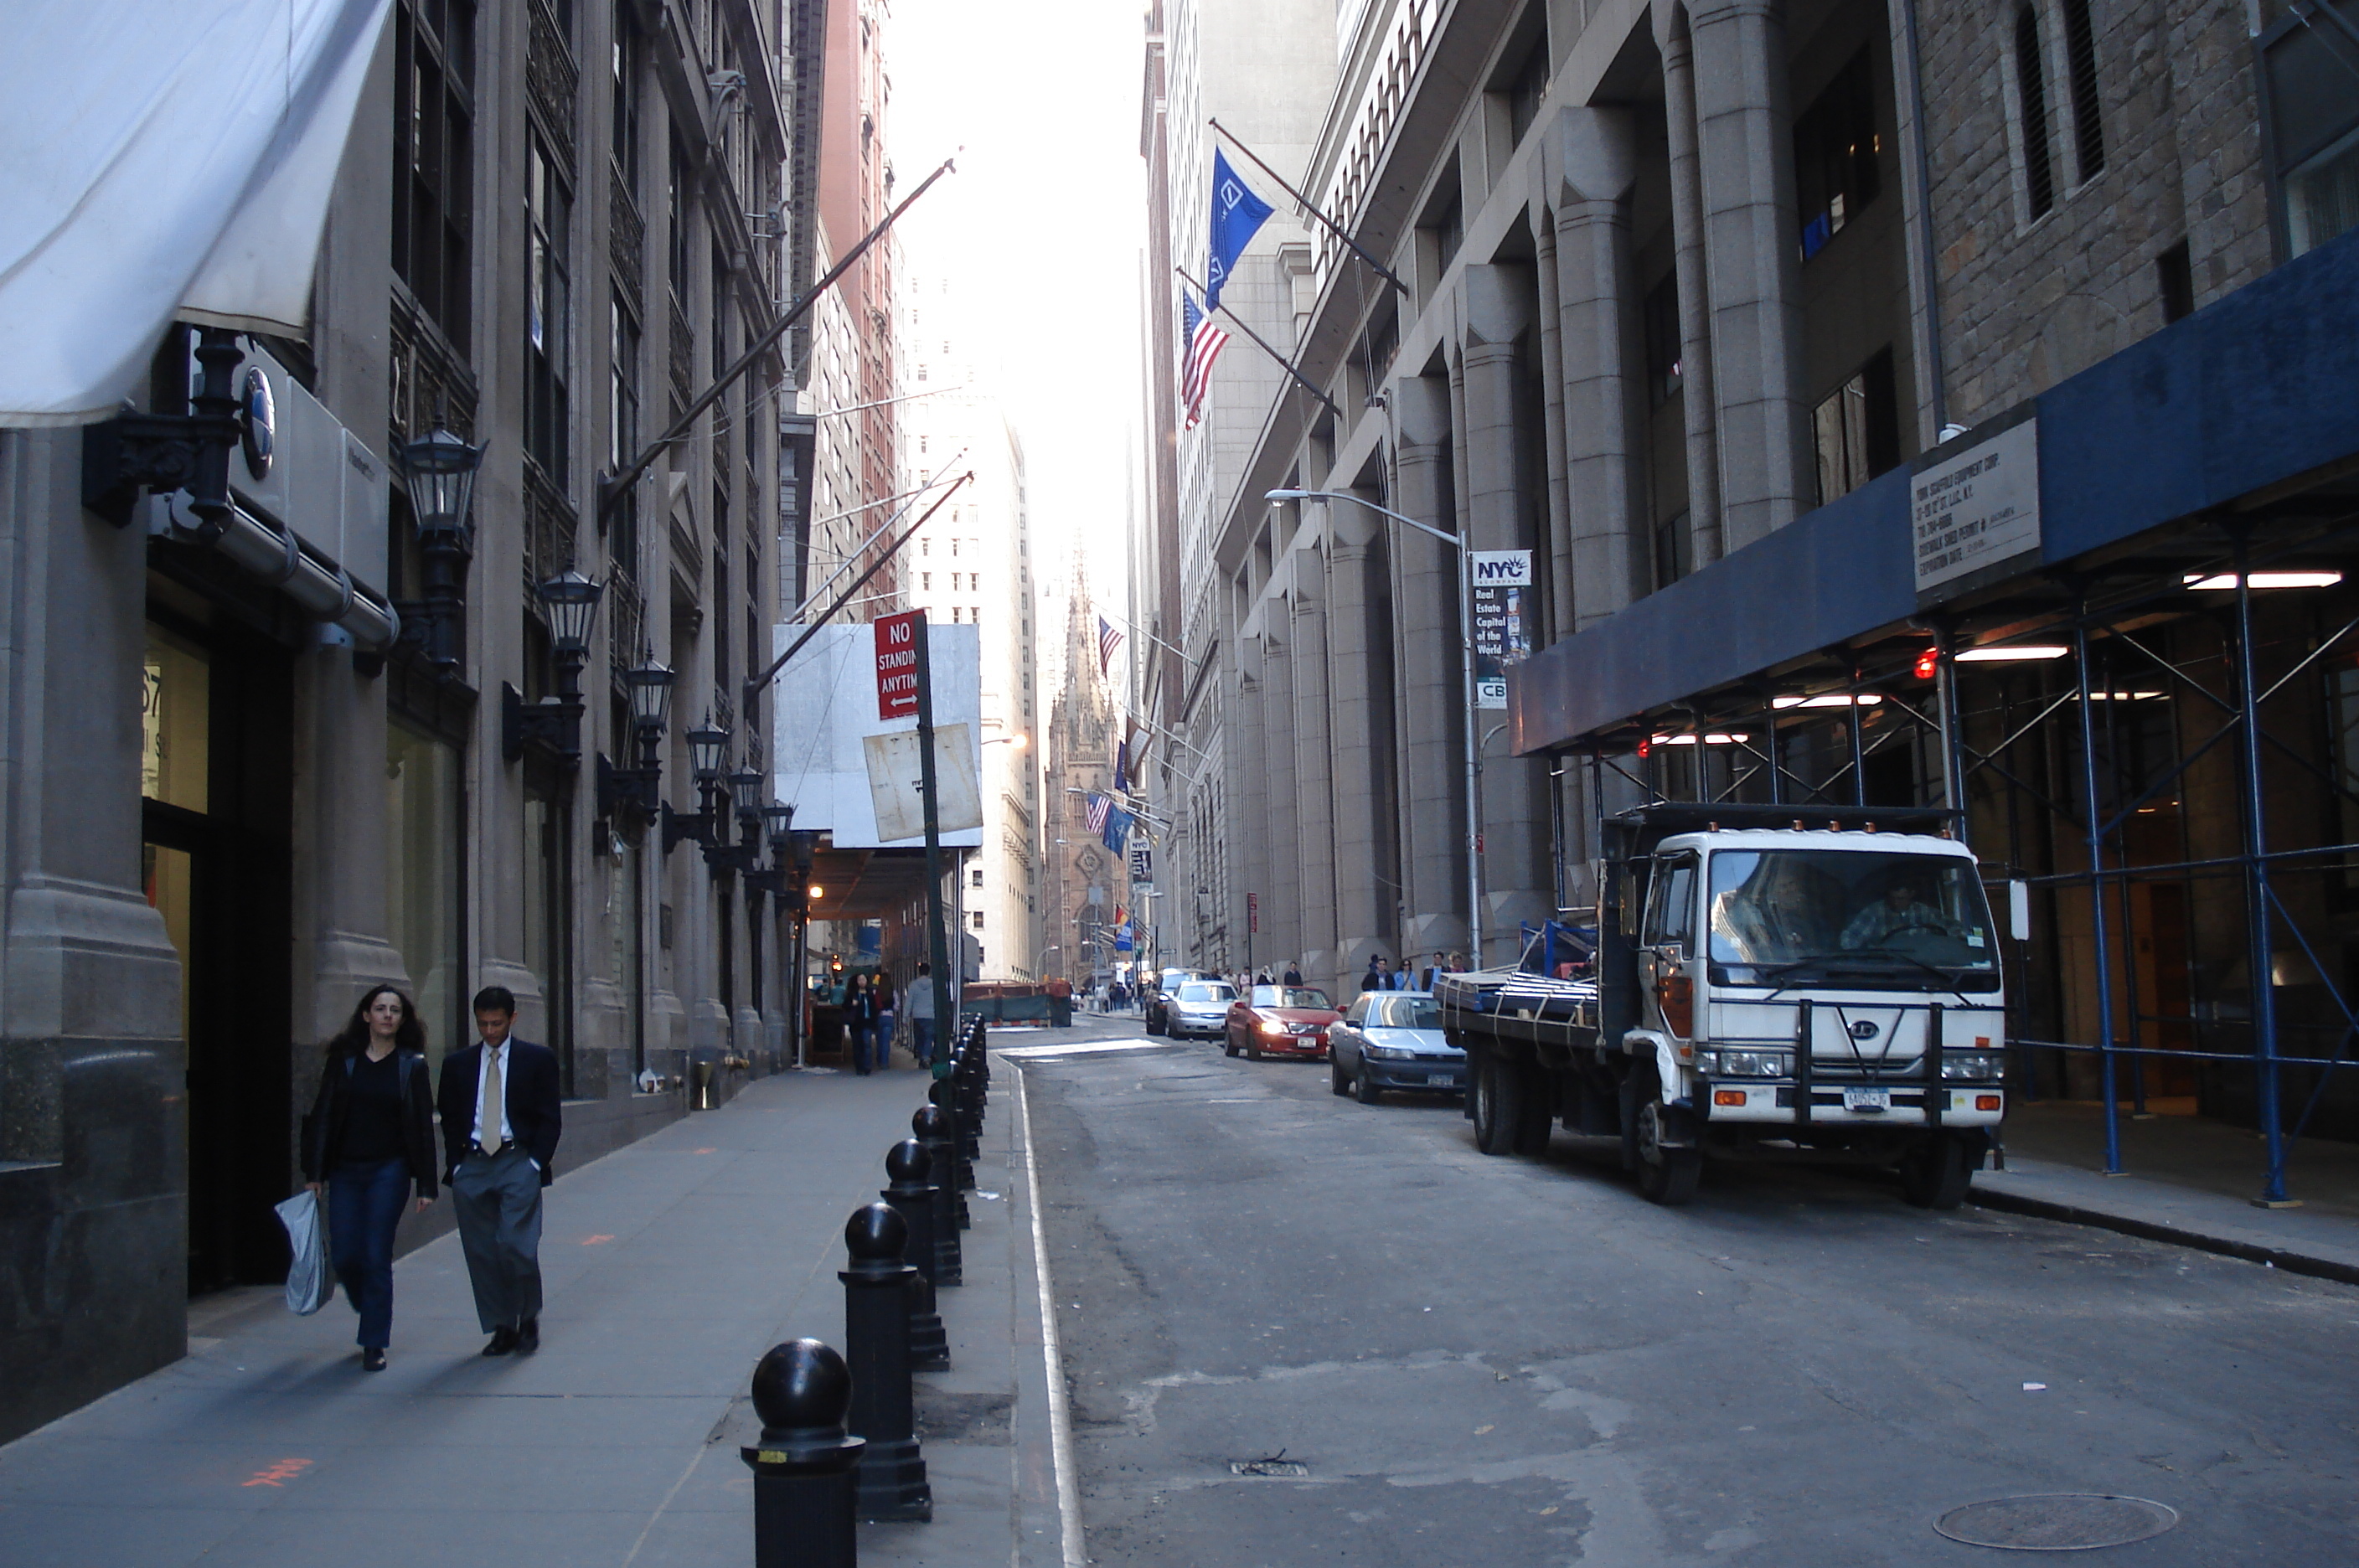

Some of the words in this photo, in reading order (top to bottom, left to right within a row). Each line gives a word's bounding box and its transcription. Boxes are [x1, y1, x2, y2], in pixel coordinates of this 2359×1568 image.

[1479, 558, 1524, 578] NYC
[1475, 588, 1494, 599] Real
[1476, 603, 1501, 613] Estate
[1476, 616, 1506, 628] Capital
[890, 622, 911, 645] NO
[1477, 630, 1485, 641] of
[1487, 630, 1501, 641] the
[1477, 644, 1502, 655] World
[879, 649, 917, 671] STANDIN
[882, 673, 918, 694] ANYTIM
